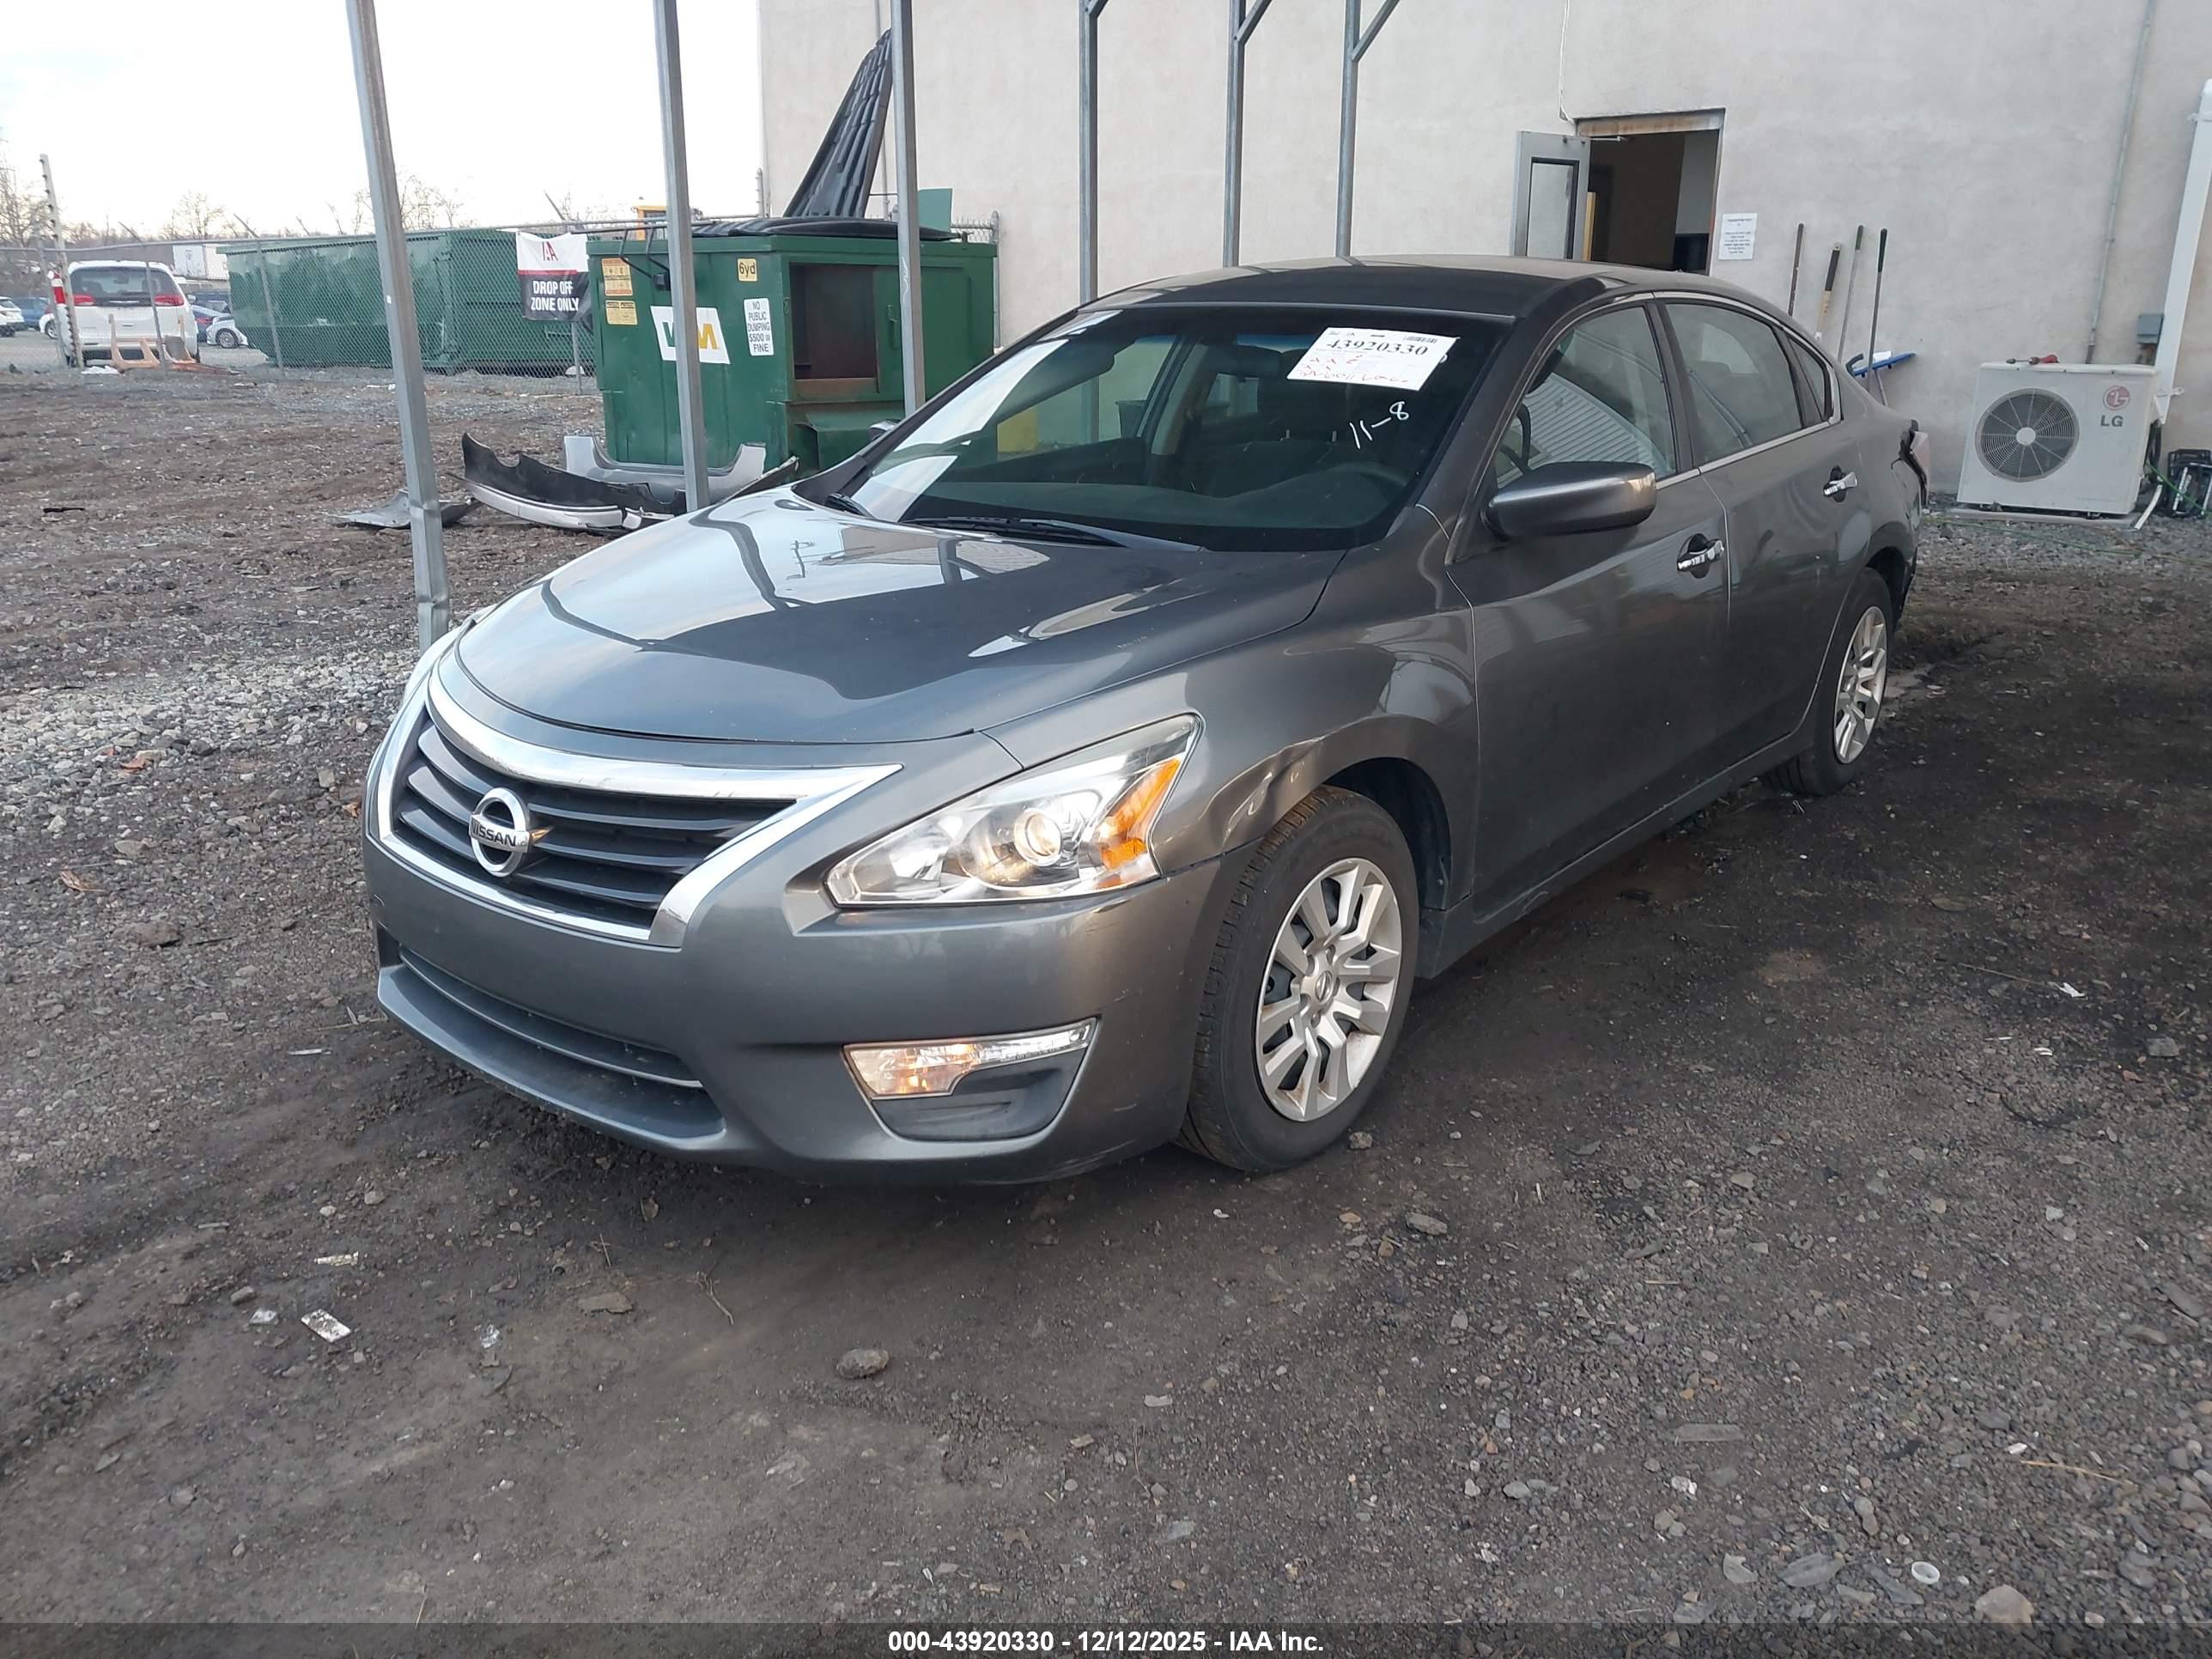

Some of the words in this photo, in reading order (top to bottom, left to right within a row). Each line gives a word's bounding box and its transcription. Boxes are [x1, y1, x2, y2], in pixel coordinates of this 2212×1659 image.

[738, 263, 756, 277] 6yd
[532, 281, 558, 295] DROP
[559, 281, 574, 295] OFF
[531, 297, 556, 311] ZONE
[556, 297, 579, 312] ONLY
[752, 301, 761, 310] NO
[748, 311, 767, 321] PUBLIC
[747, 322, 770, 332] DUMPING
[749, 333, 764, 343] $500
[753, 343, 769, 353] FINE
[1326, 338, 1429, 356] 43920330
[2100, 415, 2124, 427] LG
[471, 819, 517, 848] NISSAN
